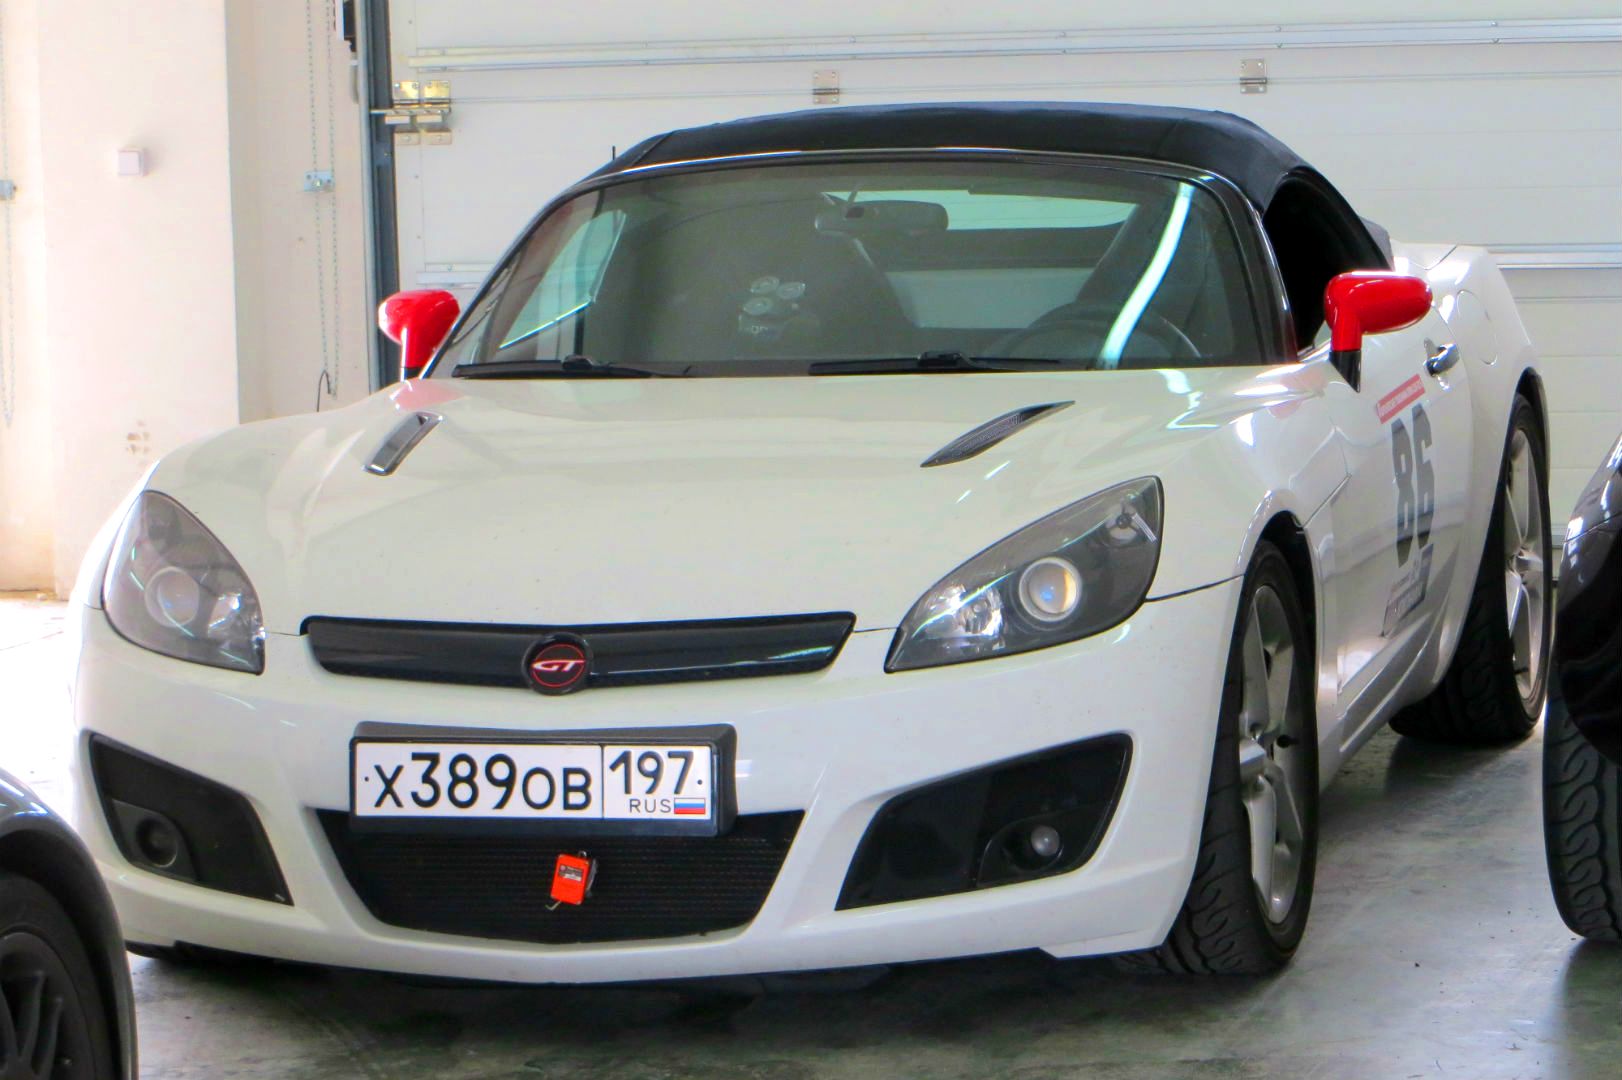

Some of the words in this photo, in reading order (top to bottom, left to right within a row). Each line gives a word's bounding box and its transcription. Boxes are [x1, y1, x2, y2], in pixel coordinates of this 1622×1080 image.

[1391, 402, 1434, 568] 86
[532, 659, 584, 672] GT
[608, 750, 694, 795] 197
[629, 799, 672, 814] RUS
